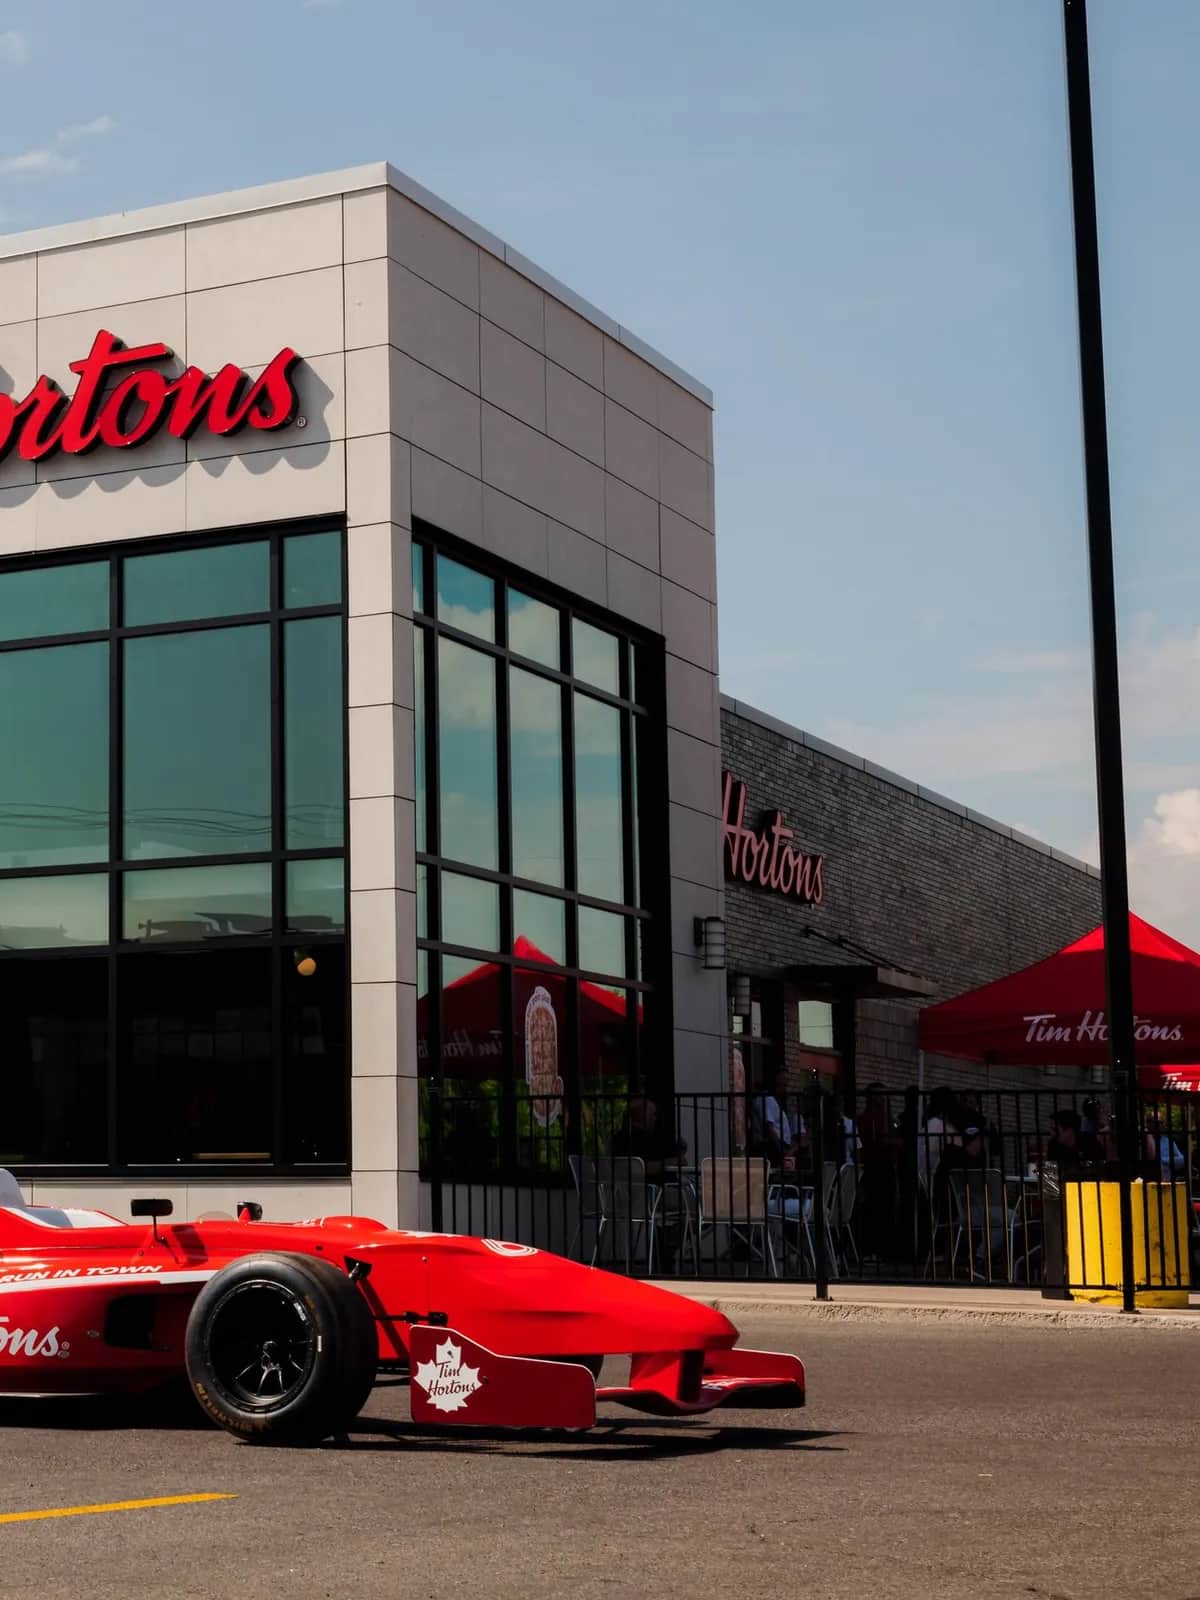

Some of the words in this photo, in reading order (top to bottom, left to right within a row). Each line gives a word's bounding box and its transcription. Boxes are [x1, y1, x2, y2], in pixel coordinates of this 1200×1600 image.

[722, 770, 824, 904] Hortons
[1023, 1013, 1070, 1042] Tim
[1160, 1072, 1193, 1092] Tim
[52, 1268, 81, 1278] IN
[87, 1265, 163, 1275] TOWN
[435, 1360, 460, 1378] Tim
[428, 1379, 476, 1396] Hortons
